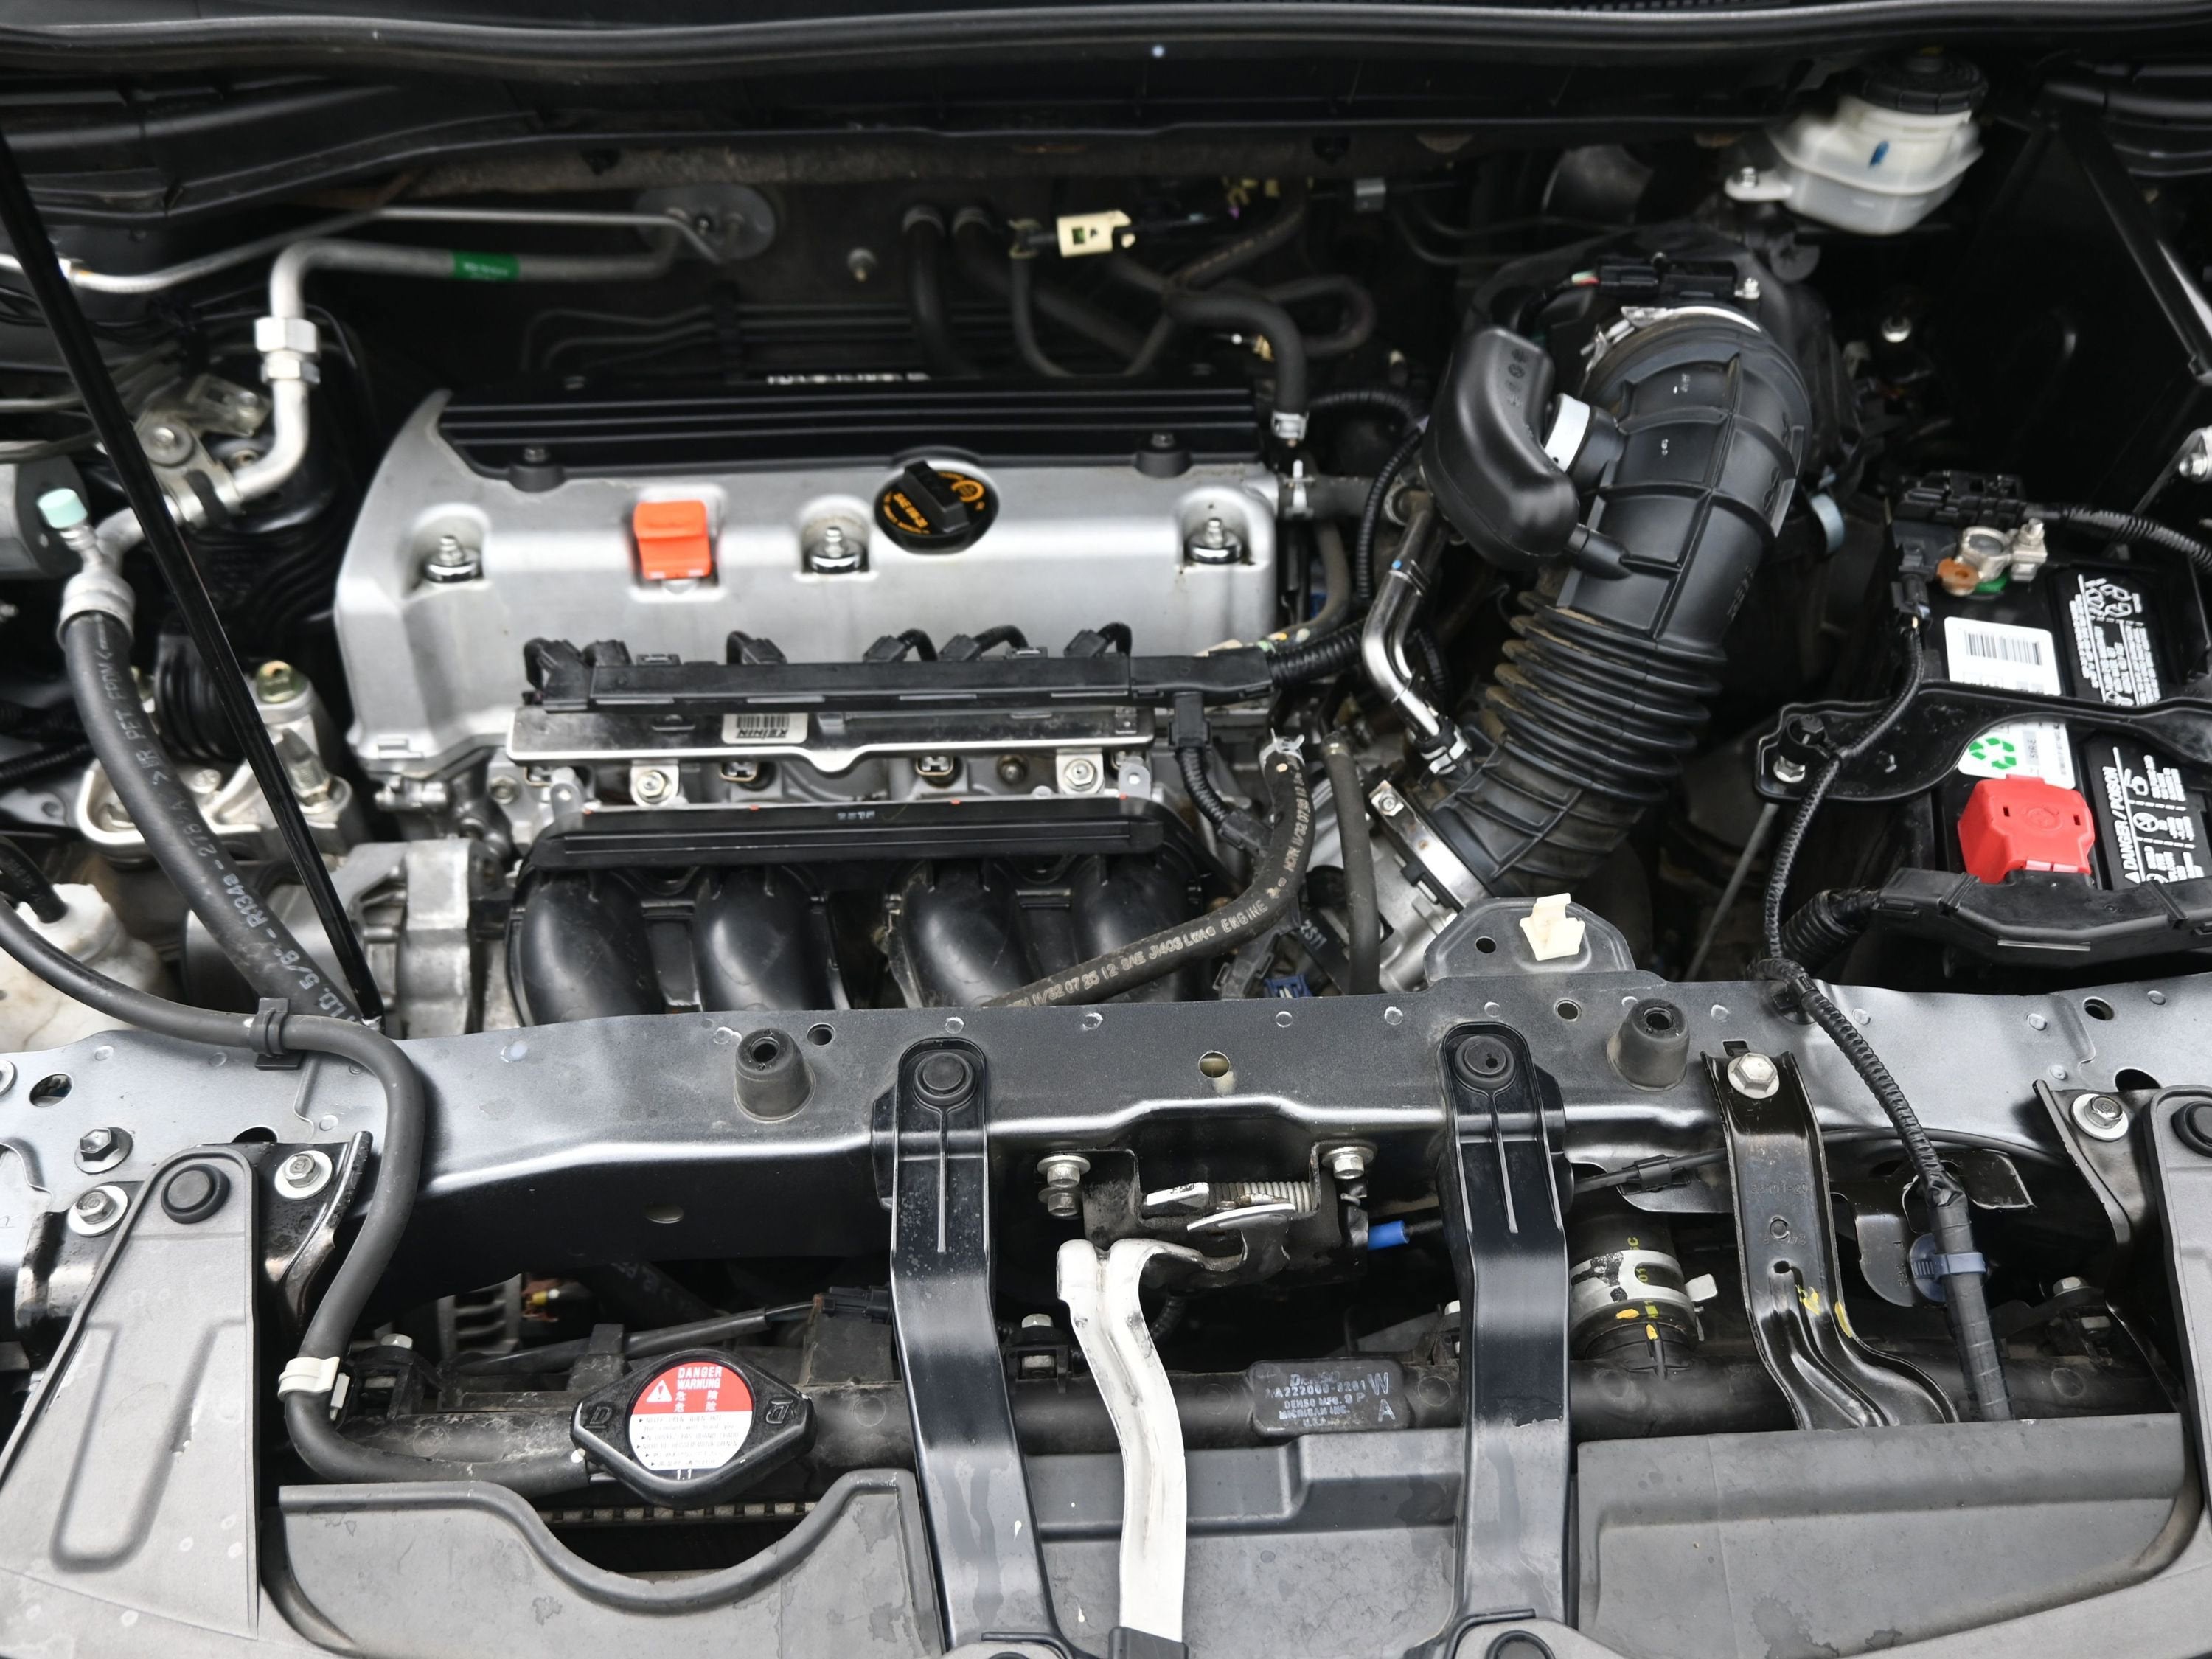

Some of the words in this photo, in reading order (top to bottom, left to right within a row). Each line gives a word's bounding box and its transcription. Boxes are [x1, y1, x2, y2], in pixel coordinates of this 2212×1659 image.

[115, 709, 147, 740] PET
[223, 873, 268, 928] R134a
[1221, 900, 1269, 933] ENGINE
[678, 1366, 723, 1379] DANGER
[676, 1378, 720, 1391] WARNUNG
[1284, 1398, 1316, 1410] DENSO
[1279, 1408, 1328, 1420] MICHIGAN
[1329, 1405, 1350, 1415] INC.
[677, 1469, 692, 1481] 1.1
